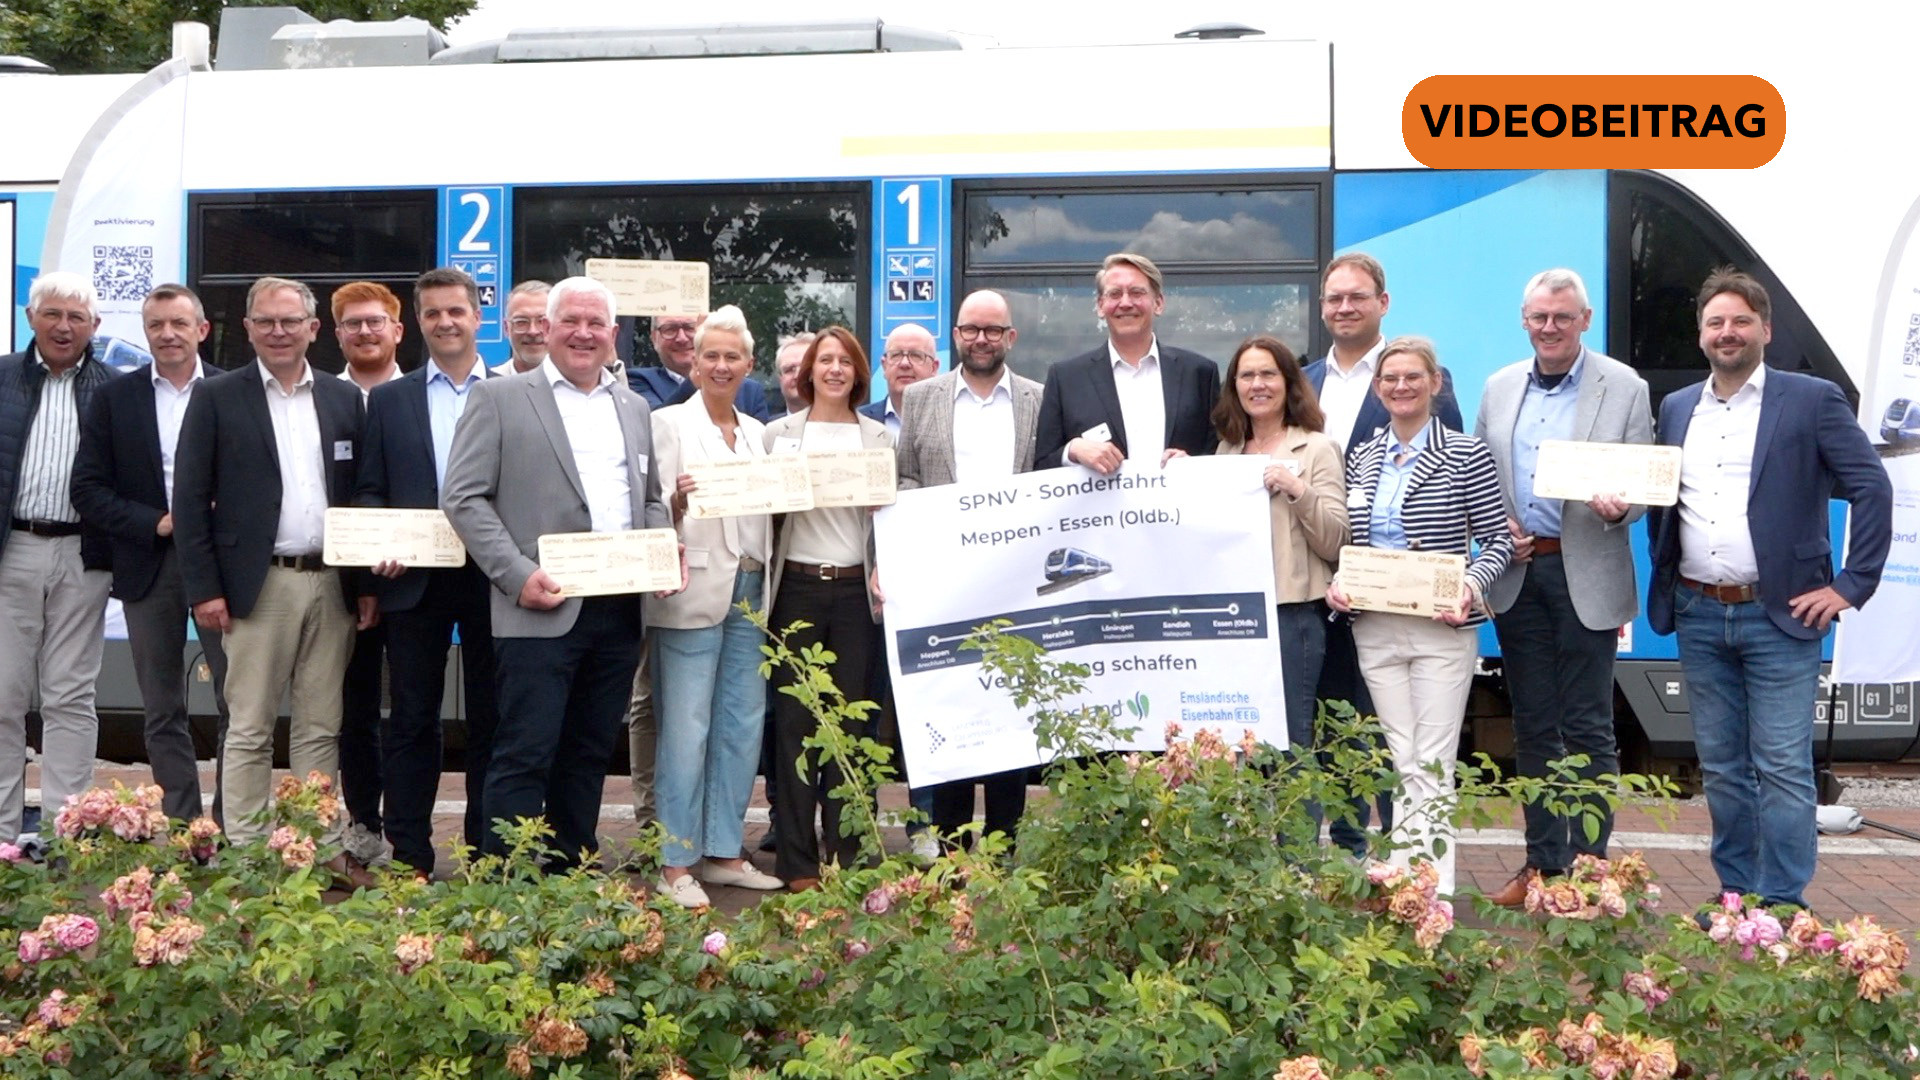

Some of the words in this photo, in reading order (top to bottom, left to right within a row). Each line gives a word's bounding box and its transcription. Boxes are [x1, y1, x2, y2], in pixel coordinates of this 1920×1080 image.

[459, 192, 490, 251] 2
[897, 184, 920, 245] 1
[959, 489, 1018, 511] SPNV
[1039, 473, 1167, 500] Sonderfahrt
[960, 524, 1041, 546] Meppen
[1059, 513, 1114, 532] Essen
[1119, 508, 1181, 529] (Oldb.)
[1212, 619, 1233, 628] Essen
[920, 649, 950, 660] Meppen
[1112, 653, 1198, 671] schaffen
[1180, 691, 1250, 704] Emsländische
[1866, 692, 1880, 706] G1
[1181, 708, 1233, 721] Eisenbahn
